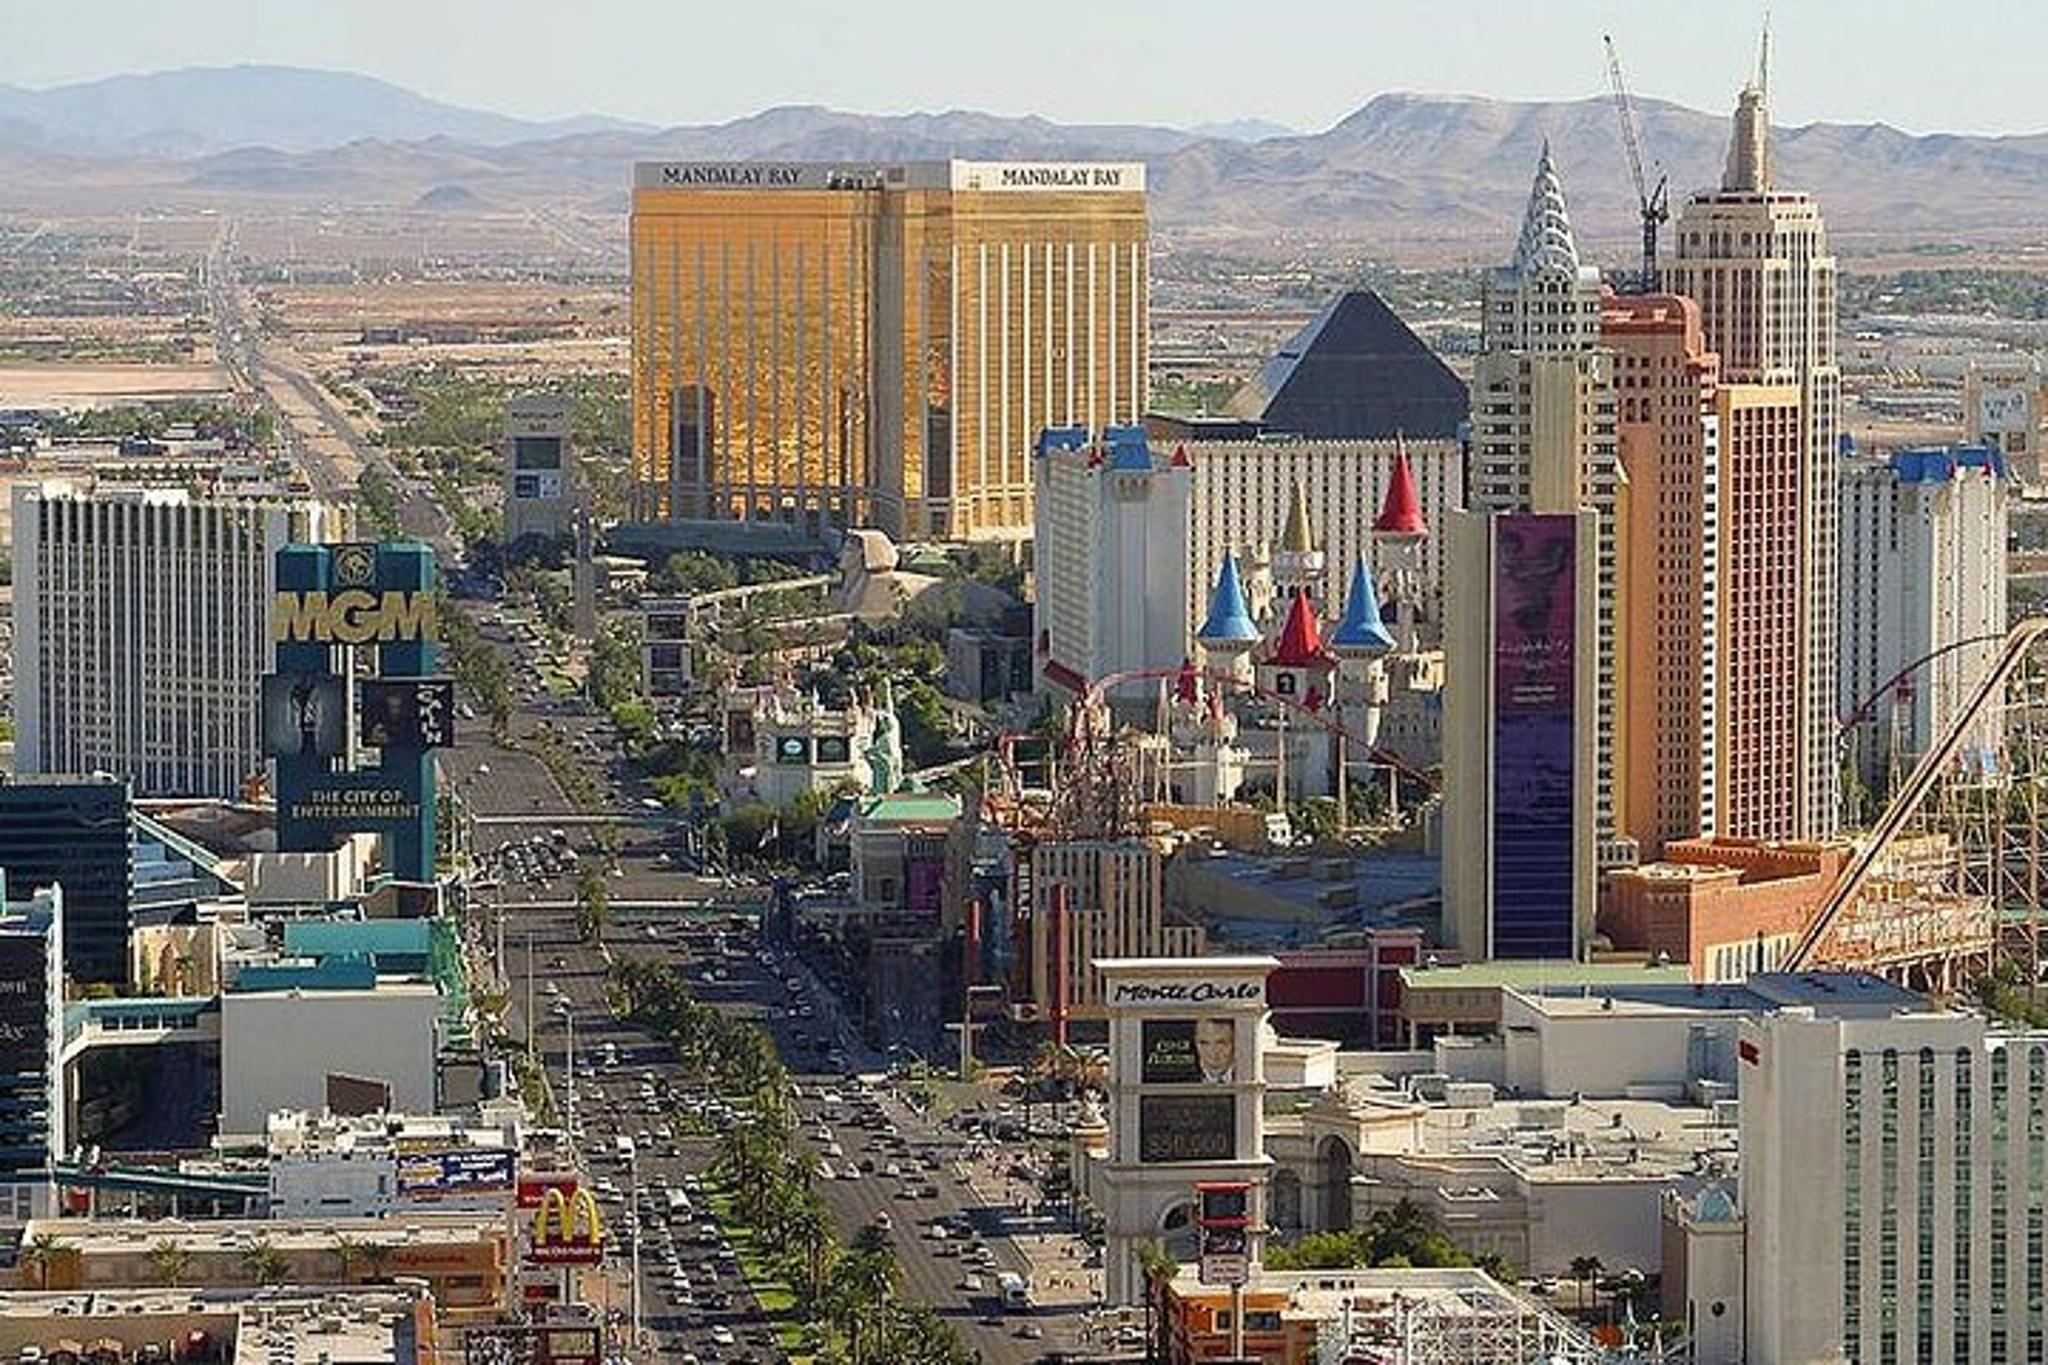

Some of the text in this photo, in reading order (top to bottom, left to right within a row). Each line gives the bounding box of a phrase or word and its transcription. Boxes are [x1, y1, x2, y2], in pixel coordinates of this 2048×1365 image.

[663, 167, 801, 185] MANDALAY BAY
[1001, 168, 1121, 186] MANDALAY BAY
[272, 590, 438, 643] MGM
[311, 789, 402, 803] THE CITY OF
[291, 804, 420, 818] ENTERTAINMENT
[1114, 982, 1261, 1002] Monte Carlo
